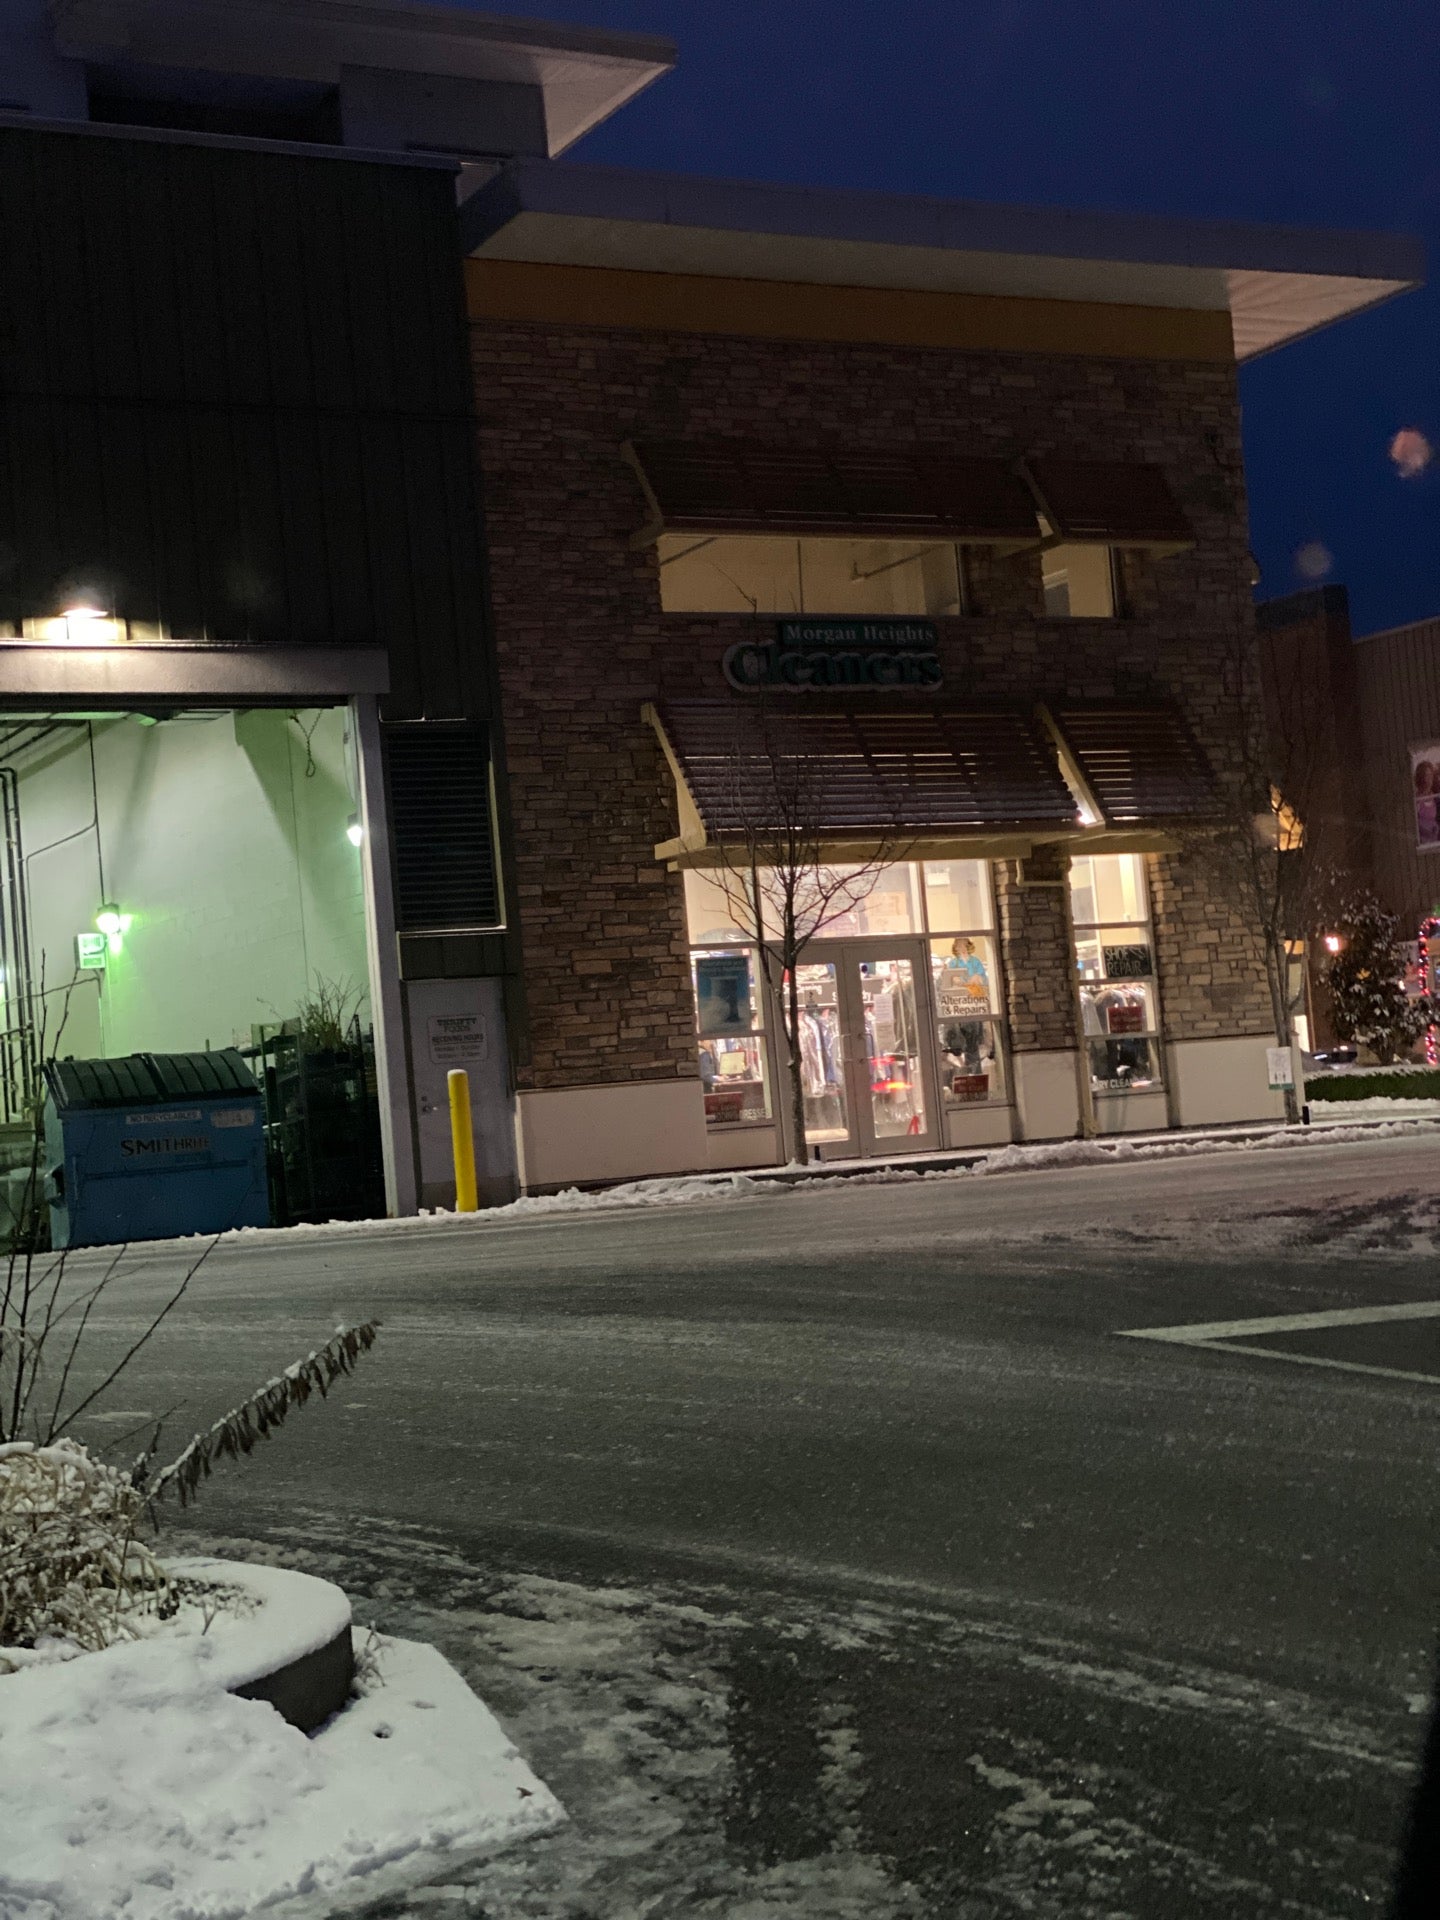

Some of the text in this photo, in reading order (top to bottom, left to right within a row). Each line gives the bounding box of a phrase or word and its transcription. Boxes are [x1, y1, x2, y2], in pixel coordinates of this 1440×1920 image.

[786, 624, 934, 644] Morgan Heights
[724, 640, 944, 691] Cleaners
[1105, 946, 1129, 961] SHOE
[1106, 960, 1143, 976] REPAIR
[941, 994, 990, 1006] Alterations
[944, 1005, 987, 1016] & Repairs
